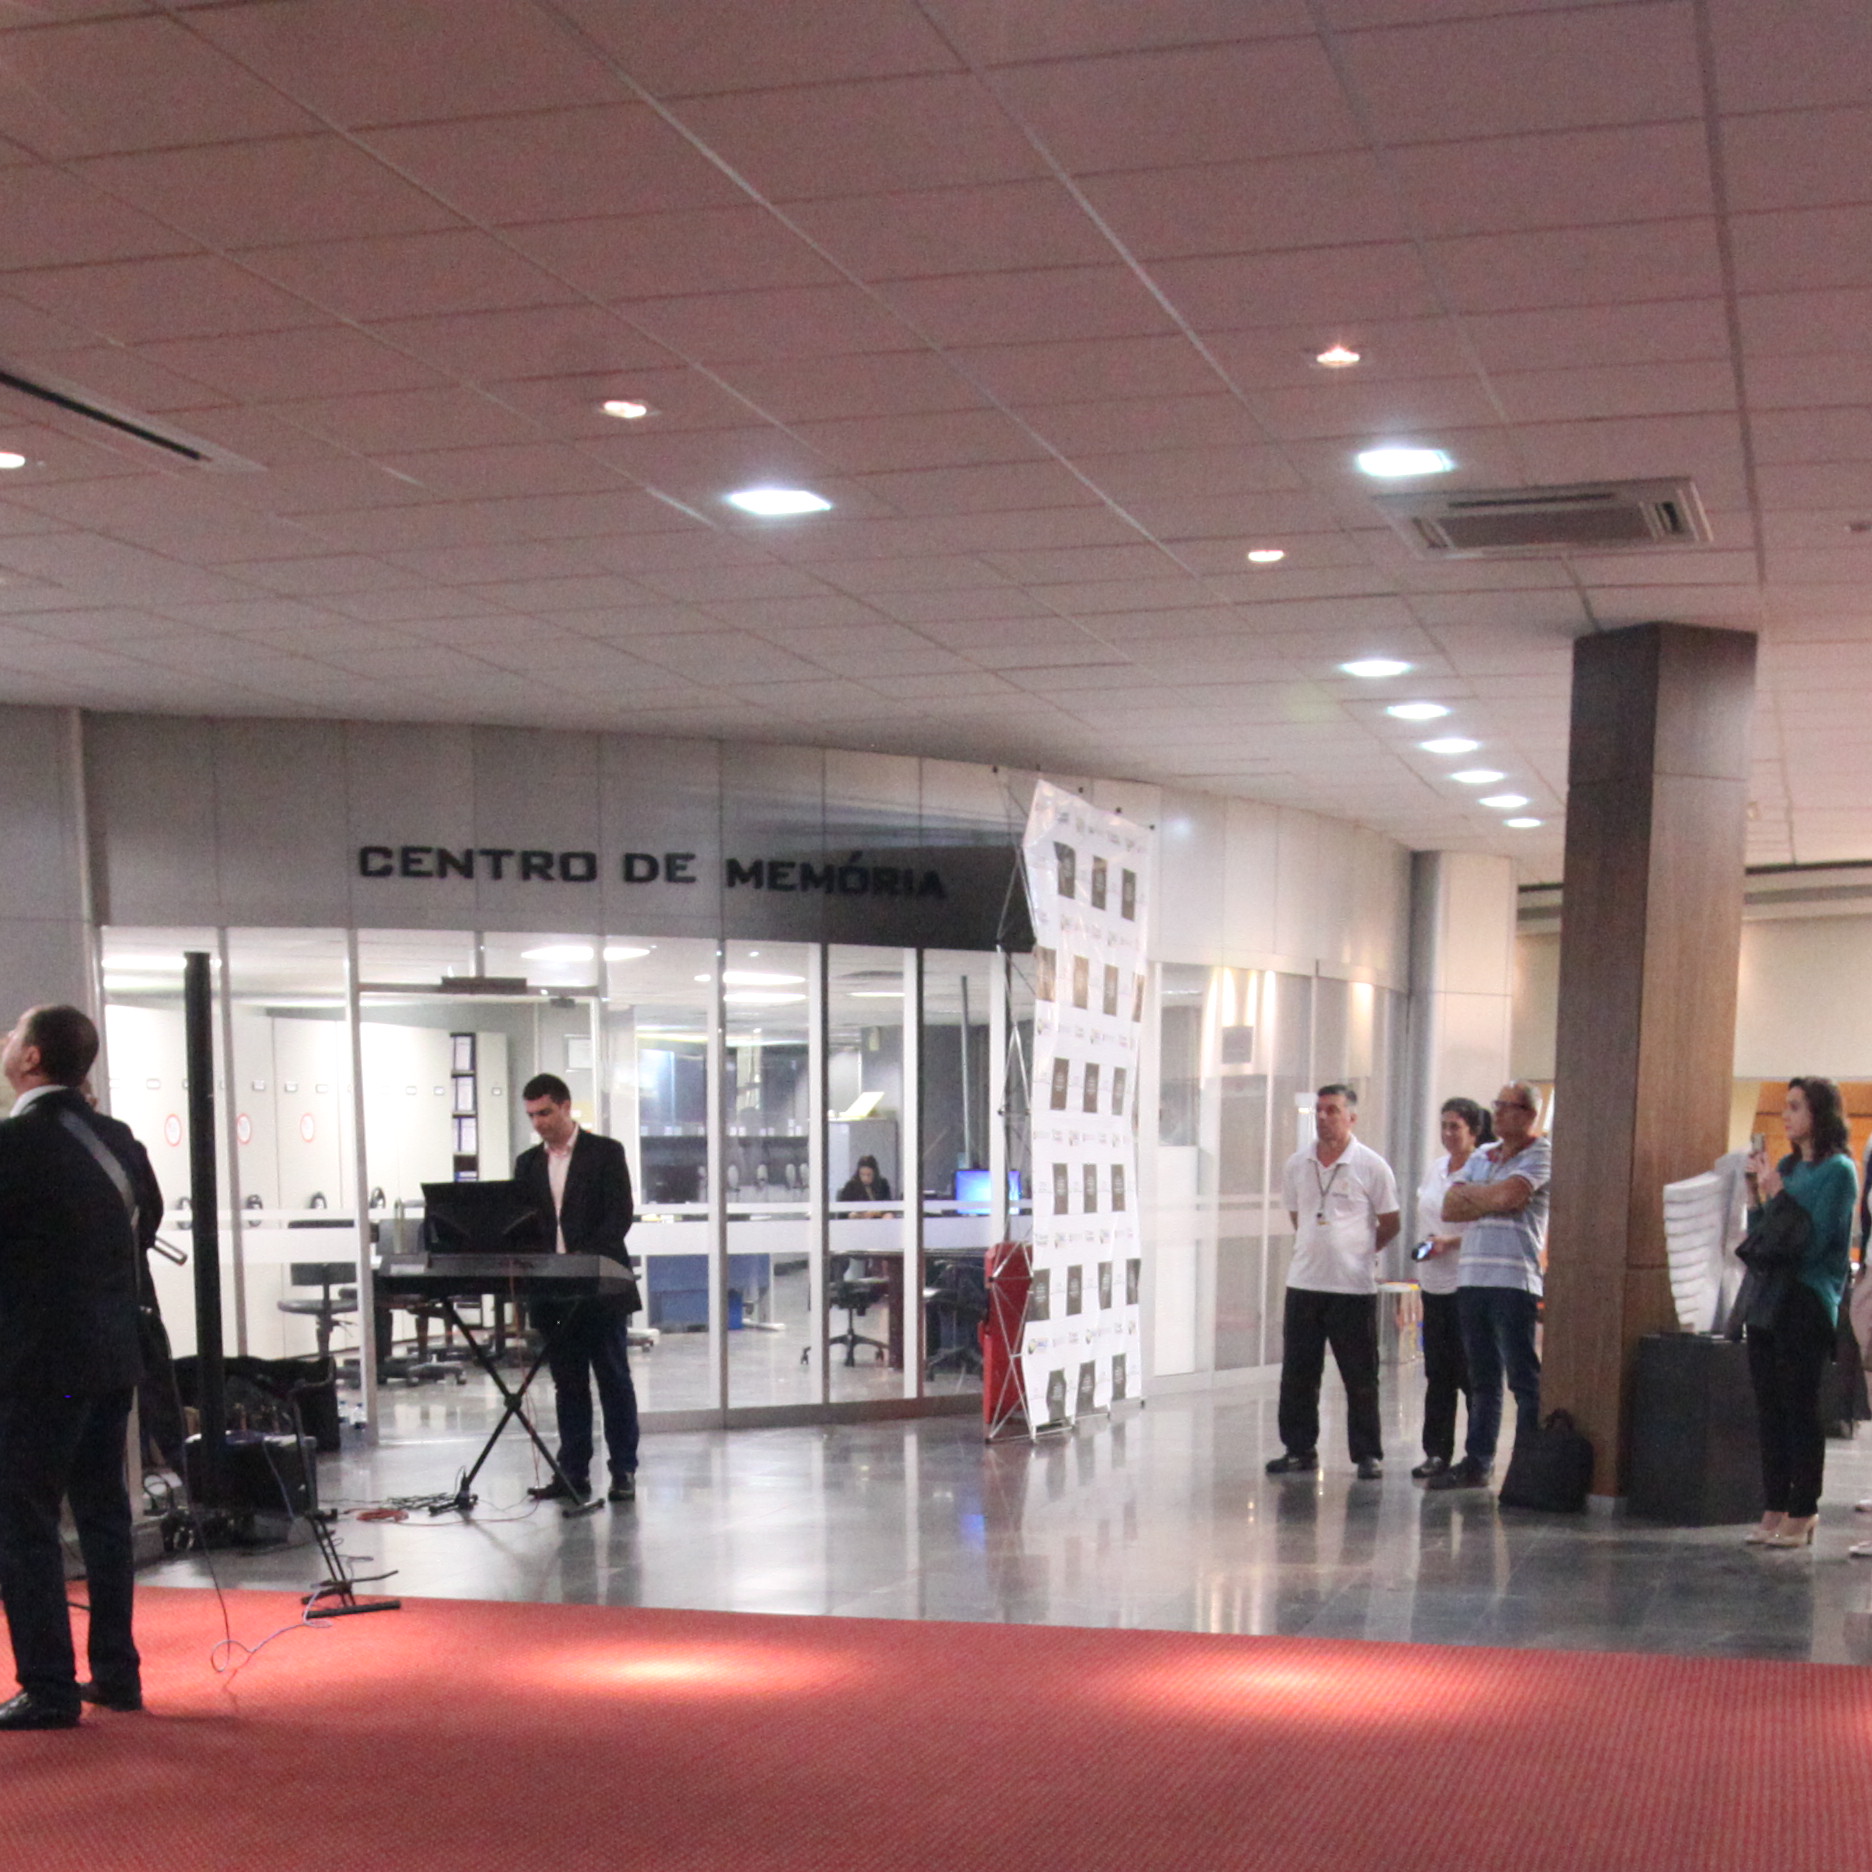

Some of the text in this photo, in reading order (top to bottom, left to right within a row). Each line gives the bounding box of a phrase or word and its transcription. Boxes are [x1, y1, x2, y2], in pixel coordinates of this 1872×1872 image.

[359, 845, 946, 899] CENTRO DE MEMÓRIA
